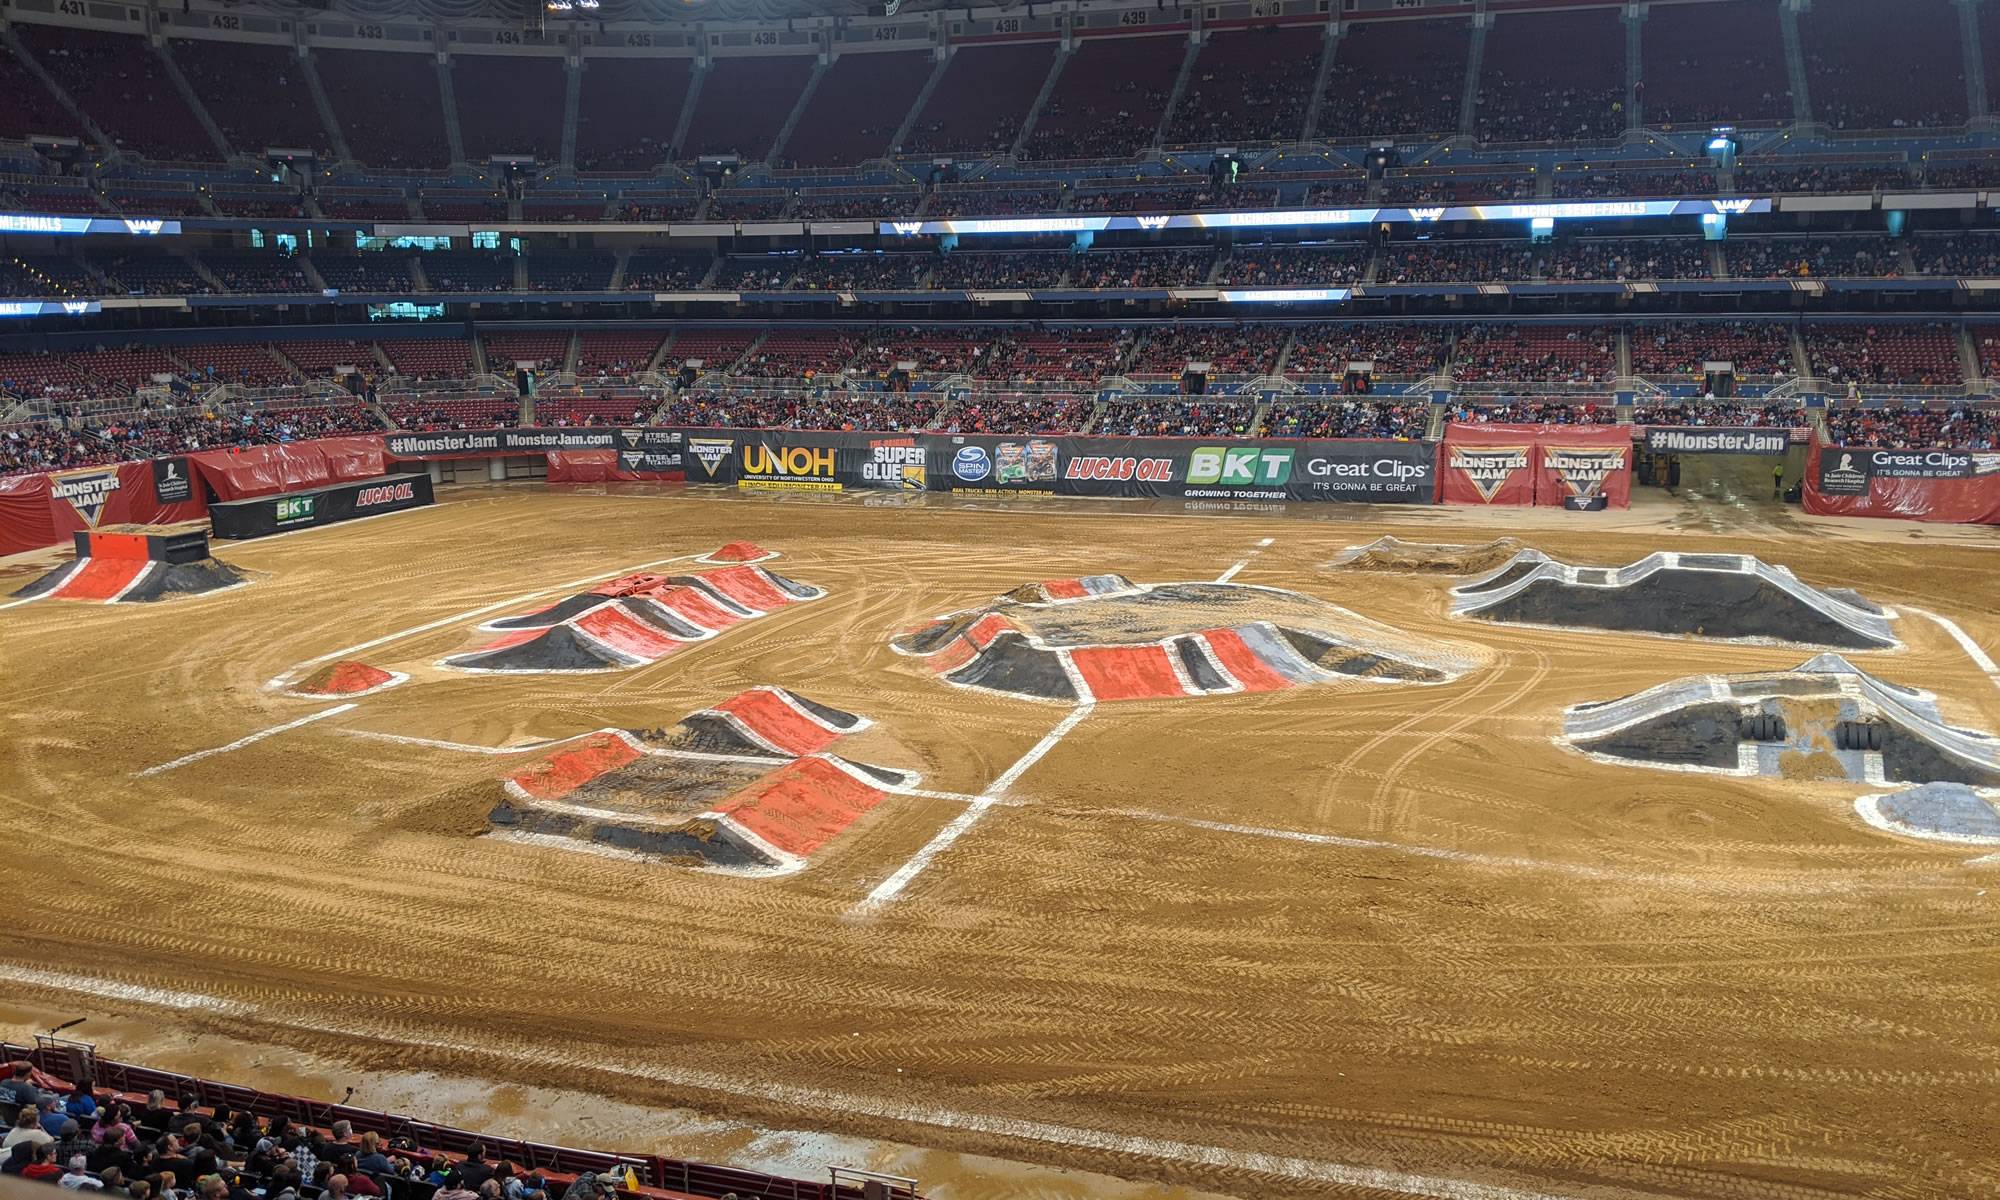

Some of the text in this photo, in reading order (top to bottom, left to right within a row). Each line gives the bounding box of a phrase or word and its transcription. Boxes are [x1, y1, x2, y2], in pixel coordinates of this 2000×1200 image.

[60, 0, 85, 16] 431
[1256, 2, 1280, 16] 40
[212, 16, 239, 30] 432
[1122, 11, 1146, 24] 439
[357, 25, 382, 39] 433
[996, 19, 1019, 33] 438
[496, 31, 520, 45] 434
[628, 33, 651, 46] 435
[754, 32, 777, 45] 436
[875, 27, 897, 41] 437
[391, 434, 498, 453] #MonsterJam
[506, 434, 613, 448] MonsterJam.com
[1651, 431, 1784, 451] #MonsterJam
[689, 445, 732, 455] MONSTER
[701, 453, 721, 461] JAM
[873, 447, 926, 465] SUPER
[744, 441, 835, 476] UNOH
[1450, 456, 1528, 468] MONSTER
[1544, 457, 1625, 469] MONSTER
[1872, 451, 1968, 469] Great Clips
[863, 463, 902, 481] GLUE
[1065, 456, 1173, 482] LUCAS OIL
[1189, 452, 1292, 480] BKT
[1307, 458, 1426, 482] Great Clips
[1892, 469, 1920, 477] GONNA
[1471, 468, 1508, 480] JAM
[1565, 469, 1604, 481] JAM
[51, 477, 120, 499] MONSTER
[1313, 482, 1417, 492] IT'S GONNA BE GREAT
[72, 493, 106, 508] JAM
[356, 483, 414, 507] LUCAS OIL
[1184, 490, 1287, 500] GROWING TOGETHER
[276, 499, 314, 517] BKT
